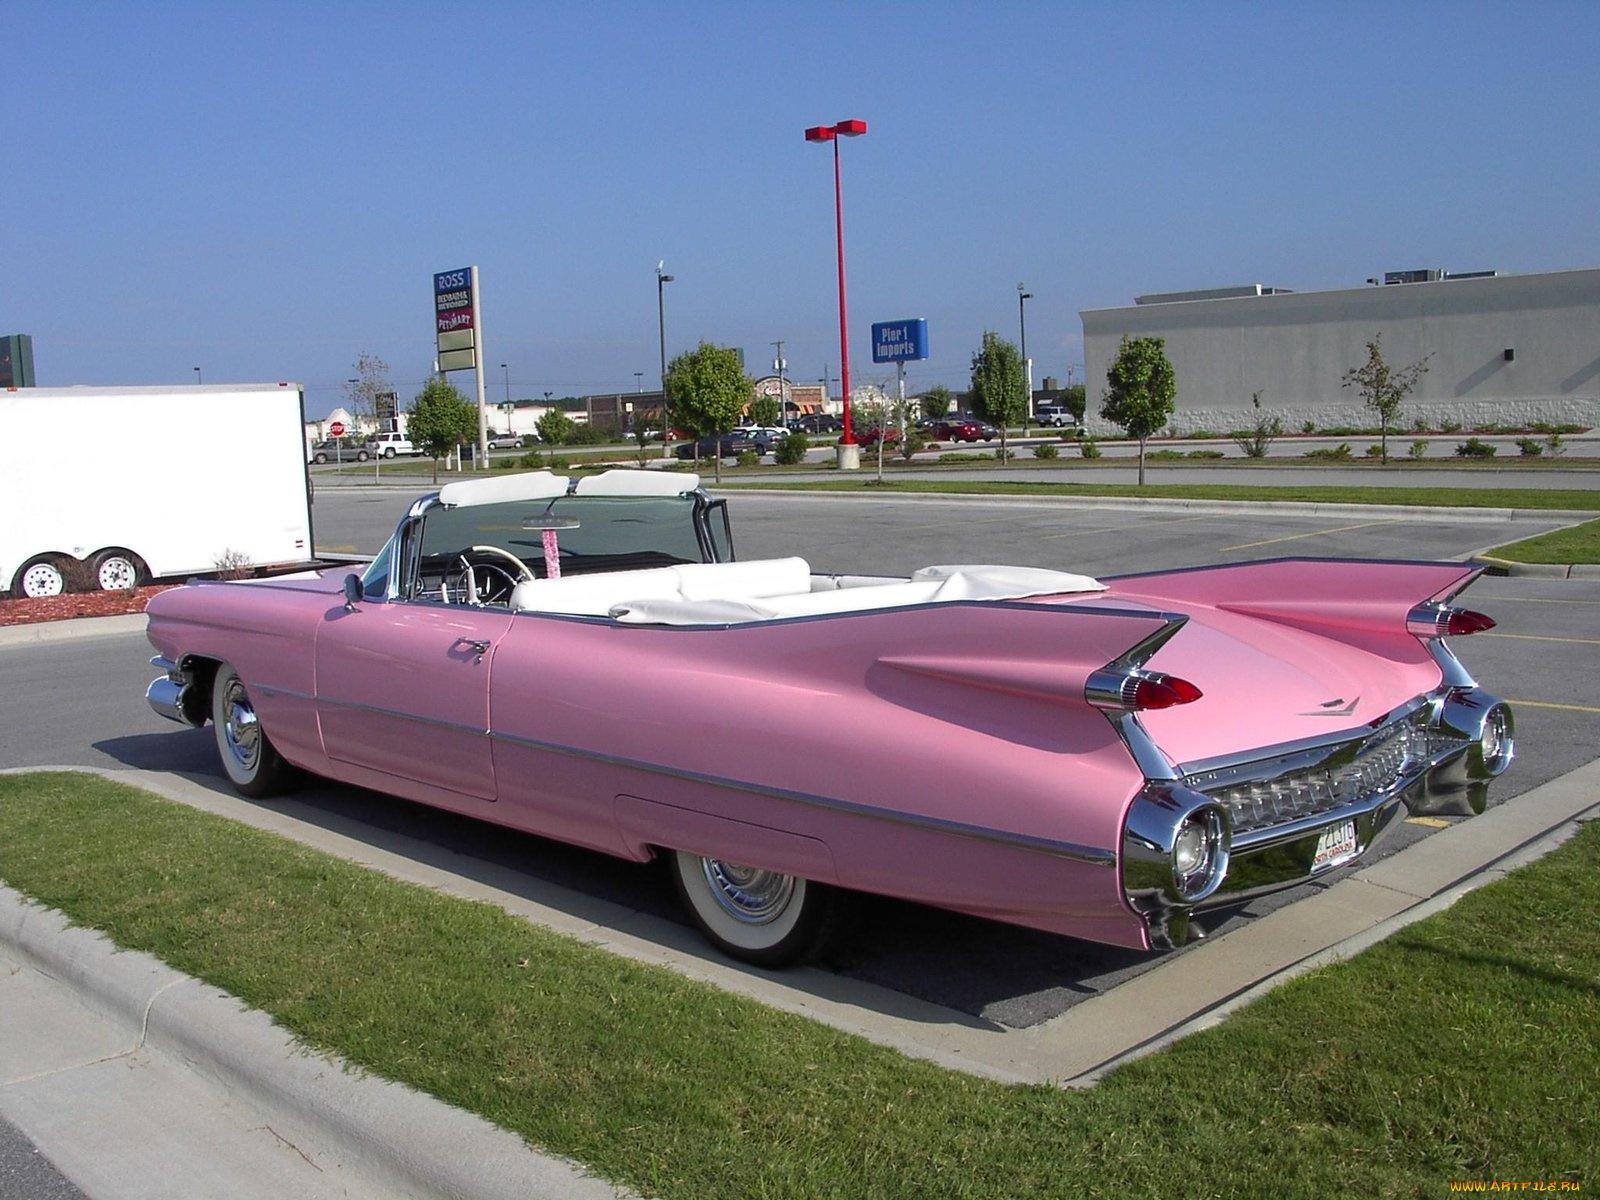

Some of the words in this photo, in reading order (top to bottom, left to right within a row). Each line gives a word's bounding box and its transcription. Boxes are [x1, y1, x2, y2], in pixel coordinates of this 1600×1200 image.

[438, 272, 464, 289] ROSS
[881, 327, 902, 343] Pier
[902, 326, 908, 340] 1
